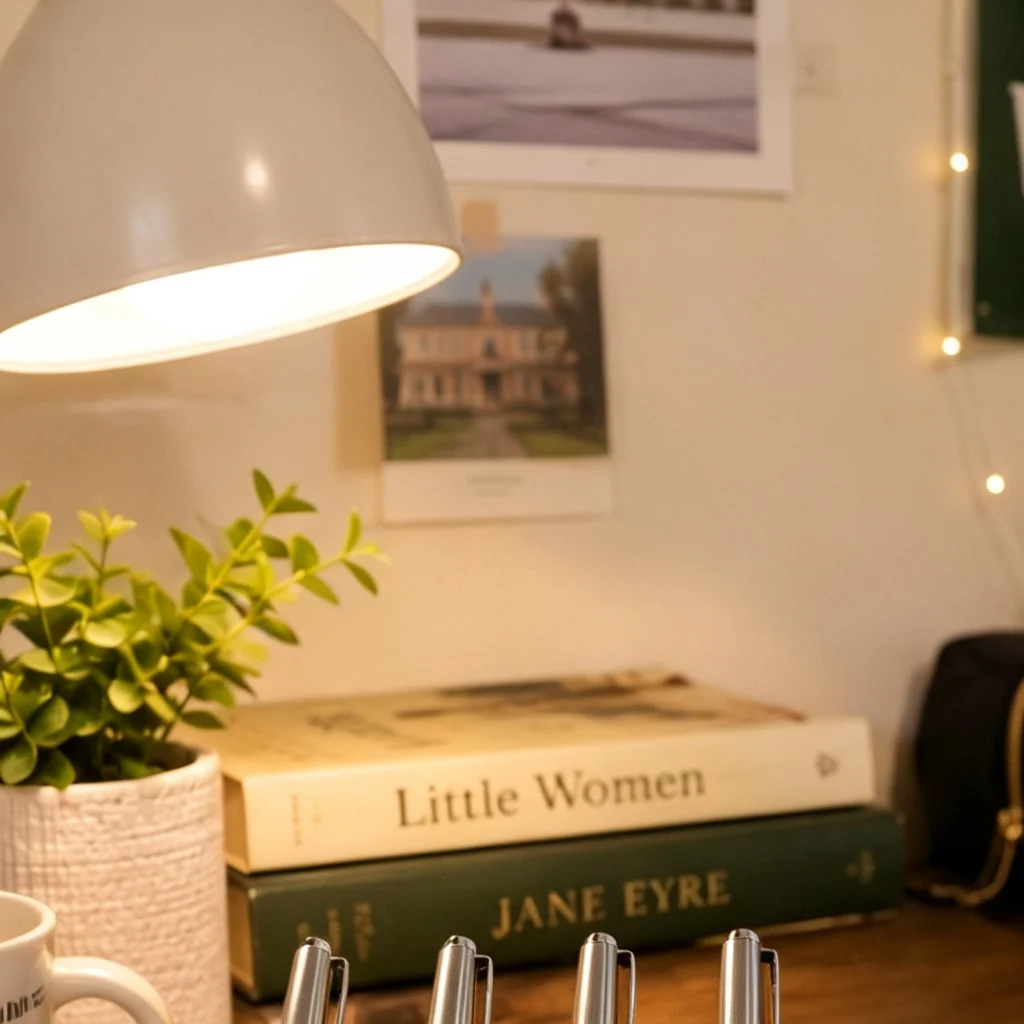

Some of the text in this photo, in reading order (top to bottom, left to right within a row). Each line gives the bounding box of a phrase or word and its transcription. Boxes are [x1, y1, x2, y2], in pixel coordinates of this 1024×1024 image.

[396, 769, 705, 827] Little Women
[491, 870, 731, 940] JANE EYRE
